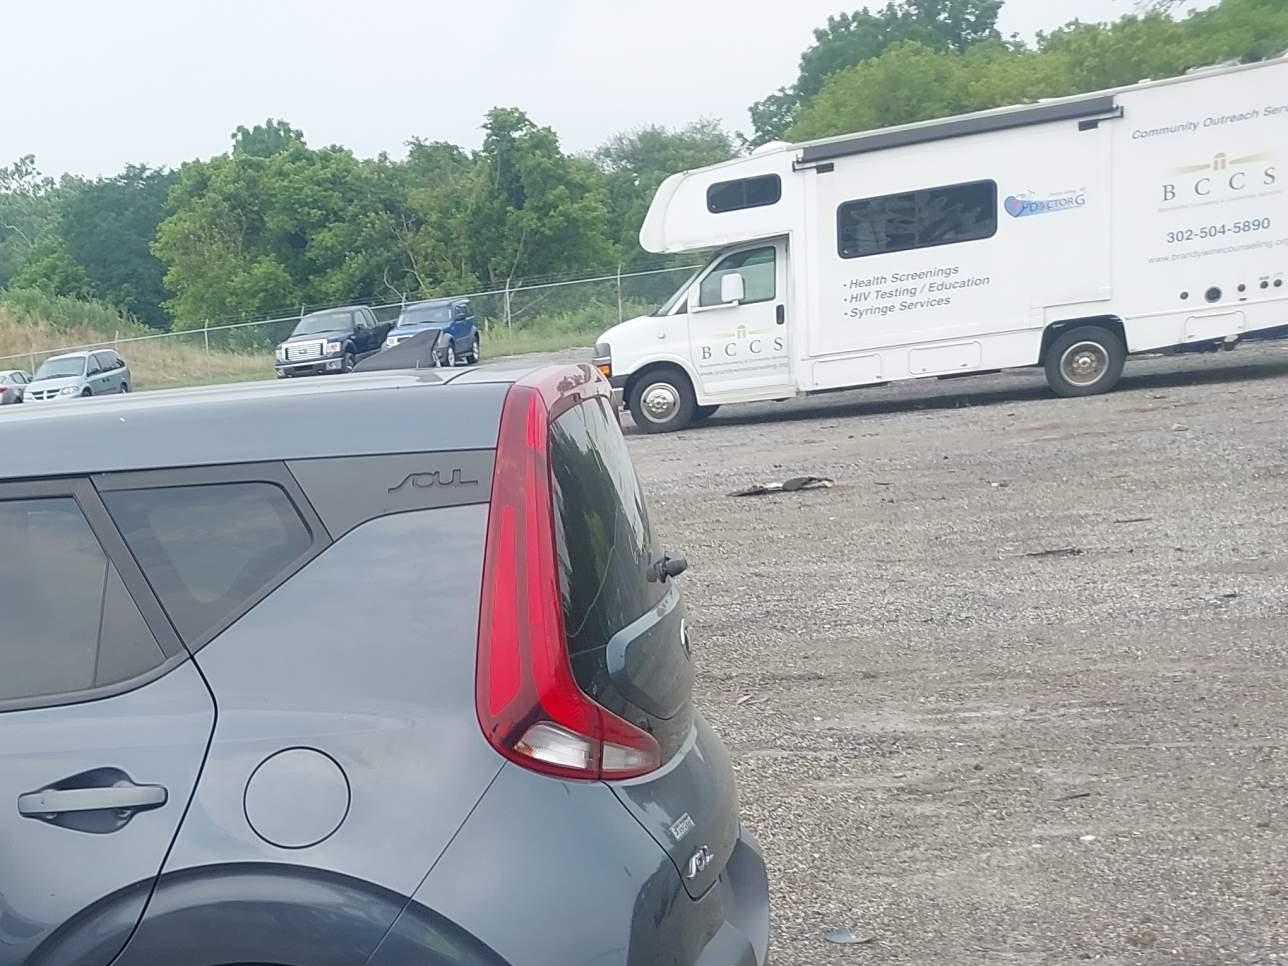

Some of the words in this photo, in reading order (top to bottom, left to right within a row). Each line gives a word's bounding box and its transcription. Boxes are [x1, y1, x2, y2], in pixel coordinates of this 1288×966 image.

[1132, 121, 1200, 140] Community
[1203, 109, 1260, 128] Outreach
[1163, 167, 1276, 201] BCCS
[1167, 217, 1271, 243] 302-504-5890
[849, 276, 887, 289] Health
[891, 265, 960, 284] Screenings
[850, 291, 871, 303] HIV
[875, 285, 917, 299] Testing
[928, 276, 990, 293] Education
[850, 304, 896, 319] Syringe
[899, 296, 951, 311] Services
[702, 336, 783, 360] BCCS
